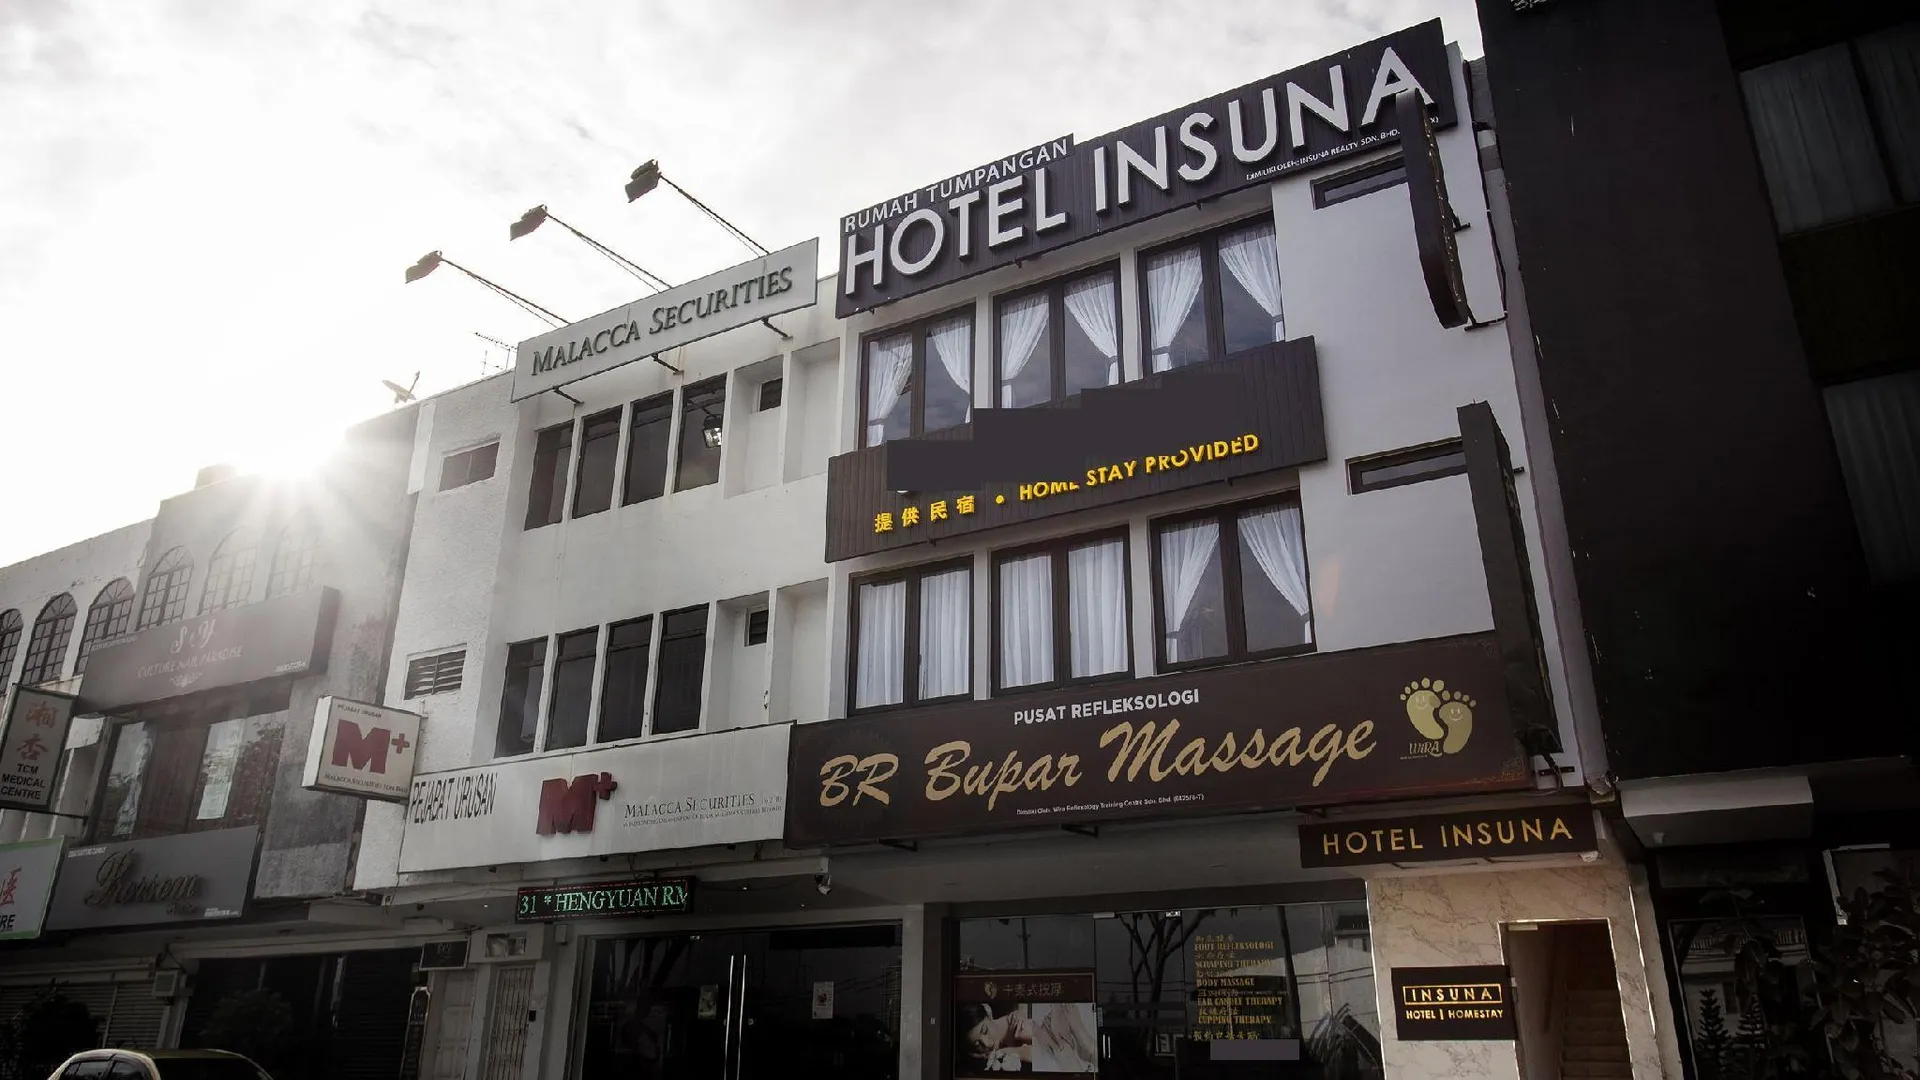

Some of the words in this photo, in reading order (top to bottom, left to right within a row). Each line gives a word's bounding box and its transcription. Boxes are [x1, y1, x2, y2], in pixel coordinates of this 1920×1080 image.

[1331, 142, 1358, 155] REALTY
[1361, 135, 1379, 146] SDN.
[1380, 128, 1400, 140] BHD.
[845, 167, 1067, 295] HOTEL
[1094, 46, 1436, 213] INSUNA
[845, 192, 917, 232] RUMAH
[926, 138, 1068, 203] TUMPANGAN
[531, 320, 641, 376] MALACCA
[649, 266, 793, 334] SECURITIES
[1086, 459, 1138, 487] STAY
[1145, 433, 1259, 473] PROVIDED
[874, 494, 975, 533] 提供民宿
[1013, 705, 1066, 725] PUSAT
[1071, 688, 1199, 718] REFLEKSOLOGI
[17, 763, 39, 775] TCM
[819, 752, 899, 808] BR
[924, 740, 1082, 811] Bupar
[1100, 718, 1377, 787] Massage
[0, 785, 41, 800] CENTRE
[1, 773, 46, 788] MEDICAL
[409, 778, 455, 824] PEJABAT
[454, 772, 497, 819] URUSAN
[1323, 828, 1424, 855] HOTEL
[1440, 817, 1574, 848] INSUNA
[554, 887, 659, 912] HENGYUAN
[1194, 943, 1215, 951] FOOT
[1195, 959, 1233, 969] SCRAPING
[1236, 958, 1272, 968] THERAPY
[1196, 978, 1220, 988] BODY
[1220, 977, 1255, 987] MASSAGE
[1411, 987, 1493, 1002] INSUNA
[1197, 997, 1213, 1006] EAR
[1214, 997, 1243, 1006] CANDLE
[1245, 996, 1283, 1005] THERAPY
[1198, 1015, 1232, 1024] CUPPING
[1235, 1015, 1272, 1024] THERAPY
[1405, 1009, 1436, 1020] HOTEL
[1448, 1009, 1504, 1019] HOMESTAY
